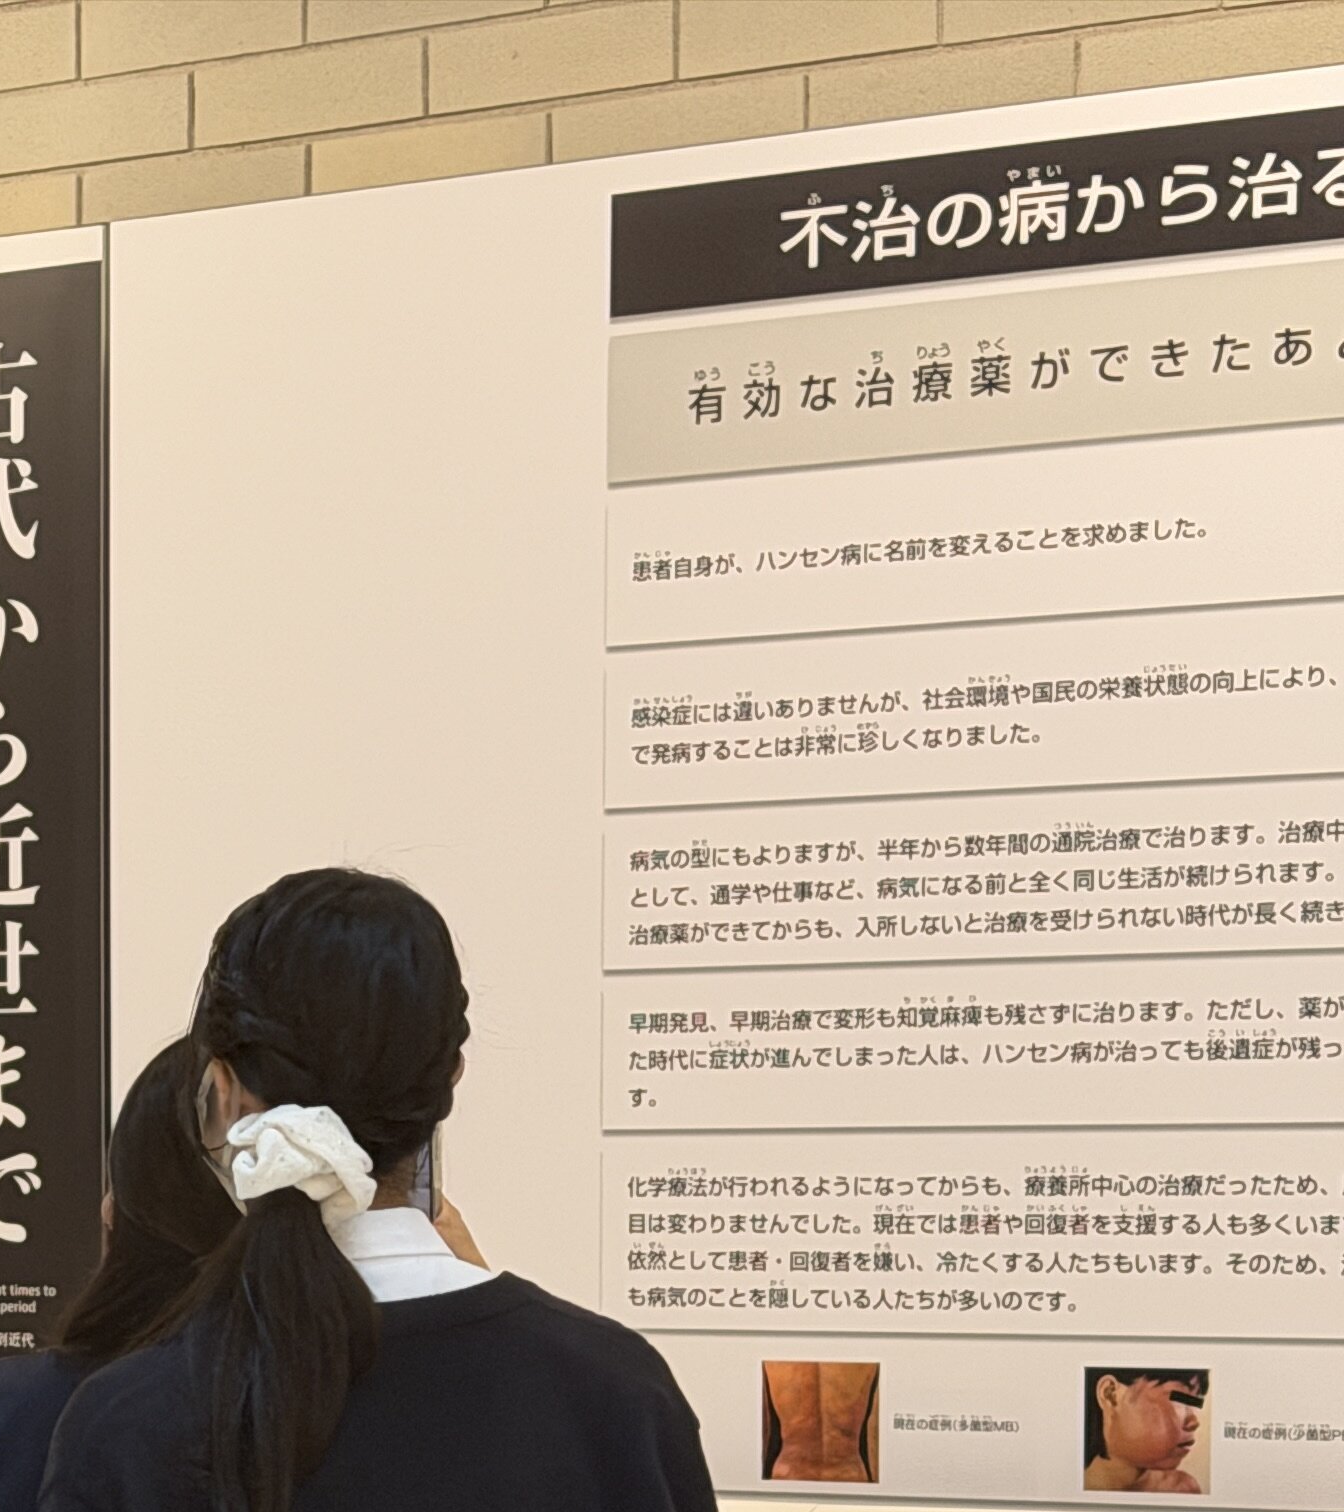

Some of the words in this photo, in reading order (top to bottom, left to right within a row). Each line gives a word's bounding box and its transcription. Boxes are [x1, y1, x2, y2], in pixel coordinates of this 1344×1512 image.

[688, 327, 1344, 426] 有効な治療薬ができたあ
[631, 517, 1209, 583] 患者自身が、ハンセン病に名前を変えることを求めました。
[630, 665, 1337, 728] 感染症には違いありませんが、社会環境や国民の栄養状態の向上により、
[631, 723, 1041, 766] で発病することは非常に珍しくなりました。
[629, 860, 1335, 909] として、通学や仕事など、病気になる前と全く同じ生活が続けられます。
[628, 1088, 657, 1108] す。
[627, 1174, 1344, 1199] 化学療法が行われるようになってからも、療養所中心の治療だったため、
[627, 1212, 1344, 1237] 目は変わりませんでした。現在では患者や回復者を支援する人も多くいま
[627, 1250, 1344, 1276] 依然として患者・回復者を嫌い、冷たくする人たちもいます。そのため、
[9, 1284, 41, 1297] times
[43, 1284, 57, 1297] to
[627, 1286, 1077, 1313] も病気のことを隠している人たちが多いのです。
[0, 1300, 37, 1316] period
[1223, 1425, 1344, 1441] 現在の症例(少菌型P
